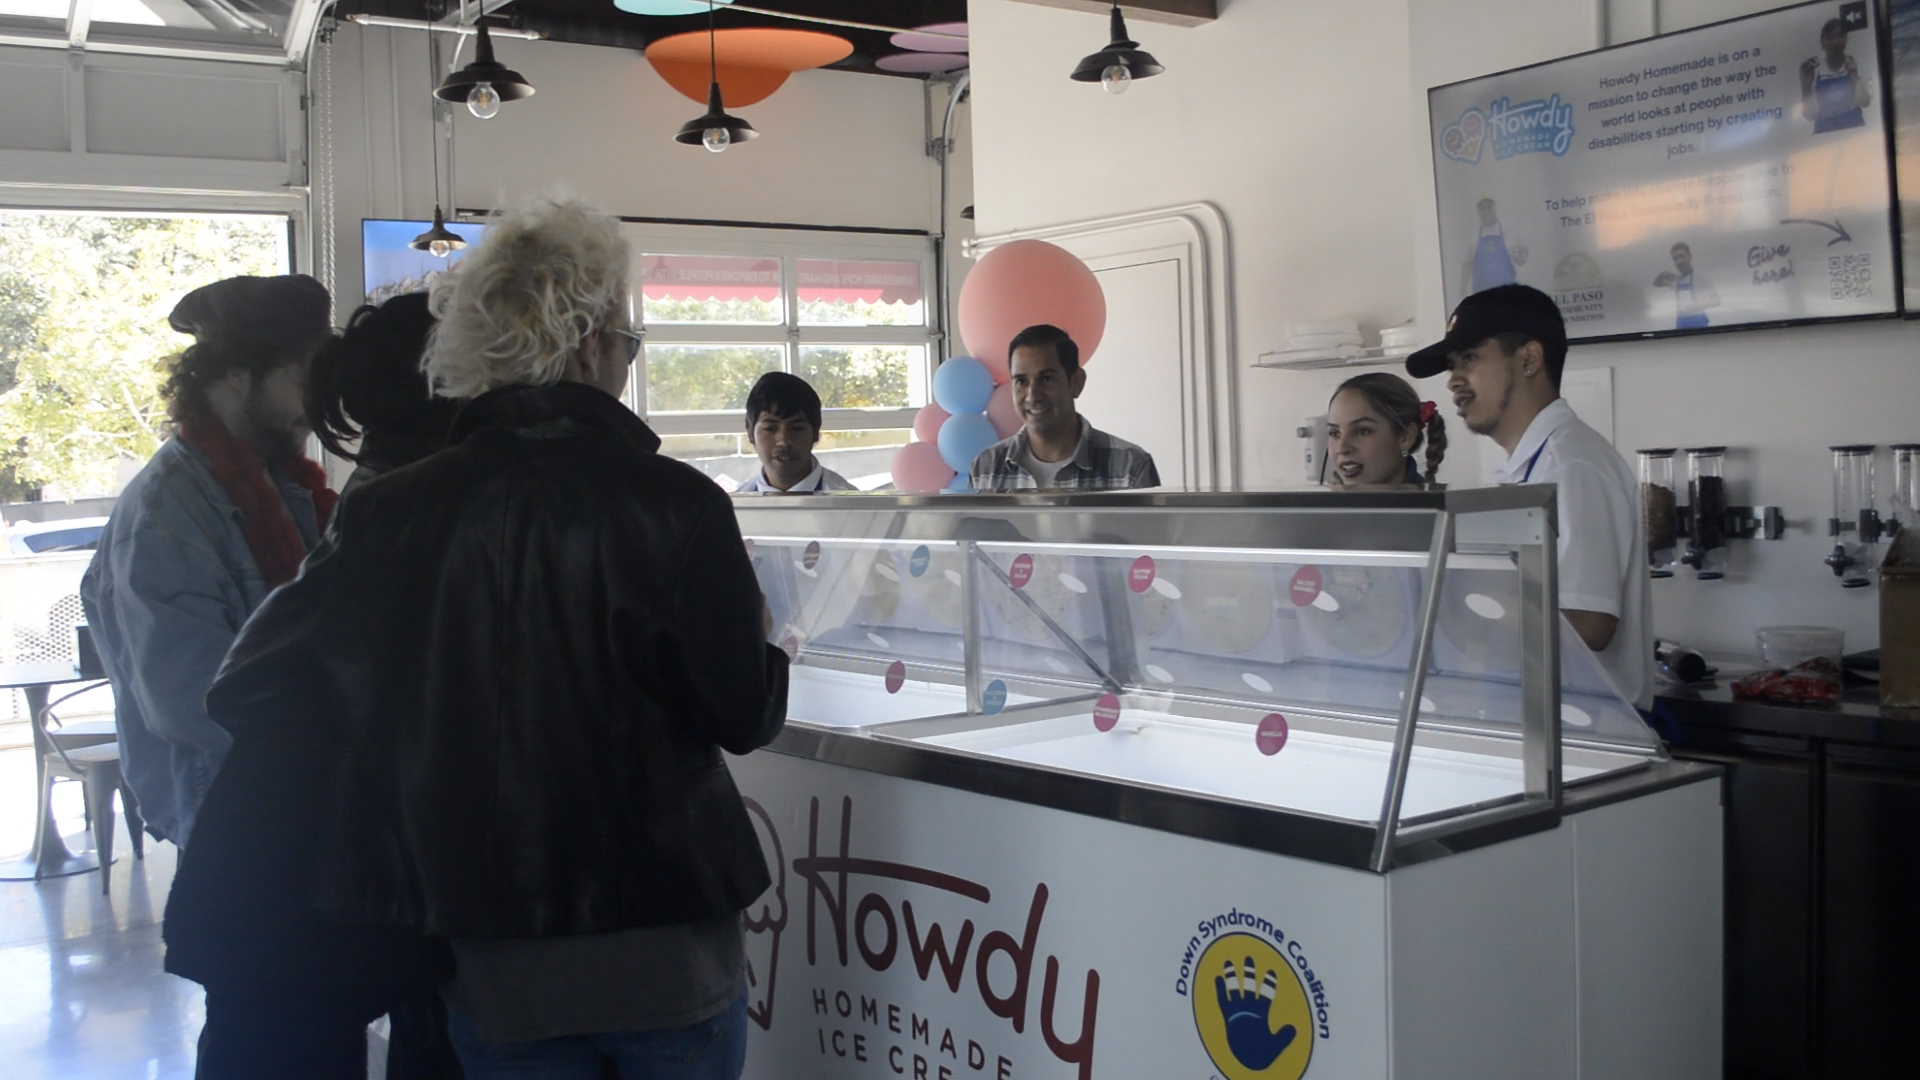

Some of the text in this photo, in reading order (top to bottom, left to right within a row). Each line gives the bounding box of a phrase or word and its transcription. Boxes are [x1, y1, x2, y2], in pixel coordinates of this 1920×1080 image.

[1588, 65, 1777, 111] mission to change the way the
[1600, 47, 1761, 89] Howdy Homemade is on a
[1488, 96, 1573, 154] Howdy
[1588, 107, 1783, 150] disabilities starting by creating
[1601, 87, 1765, 128] world looks at people with
[1667, 143, 1698, 159] jobs.
[1545, 200, 1560, 211] To
[1561, 196, 1586, 209] help
[1782, 163, 1795, 175] to
[1561, 216, 1582, 228] The
[1585, 213, 1595, 224] El
[1747, 245, 1790, 268] Give
[1752, 260, 1794, 285] here!
[1562, 303, 1603, 313] MMUNITY
[1573, 290, 1603, 303] PASO
[793, 796, 1100, 1080] Howdy
[1176, 907, 1330, 1040] Down Syndrome Coalition
[813, 988, 1012, 1080] HOMEMADE
[818, 1028, 952, 1080] ICE CRE
